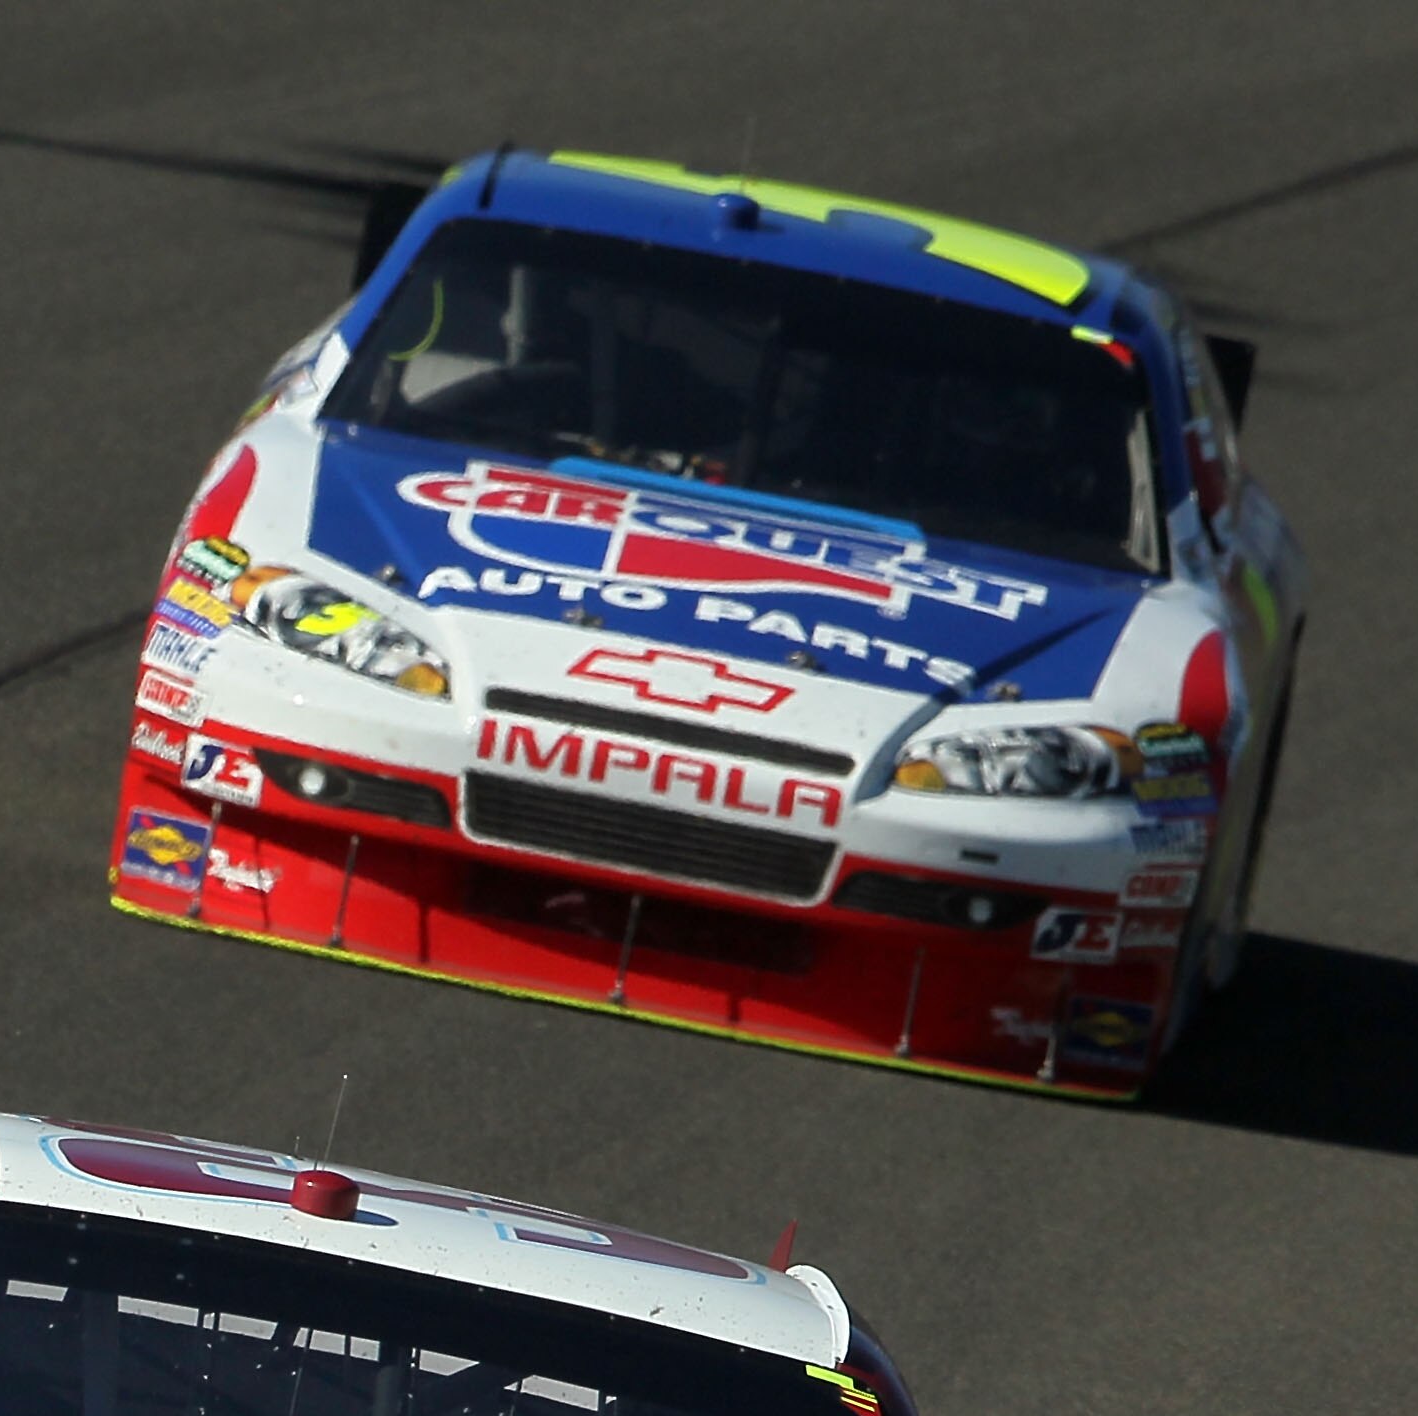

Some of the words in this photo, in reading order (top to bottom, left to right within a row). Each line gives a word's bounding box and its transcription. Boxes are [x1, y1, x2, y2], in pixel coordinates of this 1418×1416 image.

[418, 566, 667, 610] AUTO
[696, 596, 976, 689] PARTS
[477, 720, 843, 827] IMPALA
[1037, 913, 1115, 951] JE
